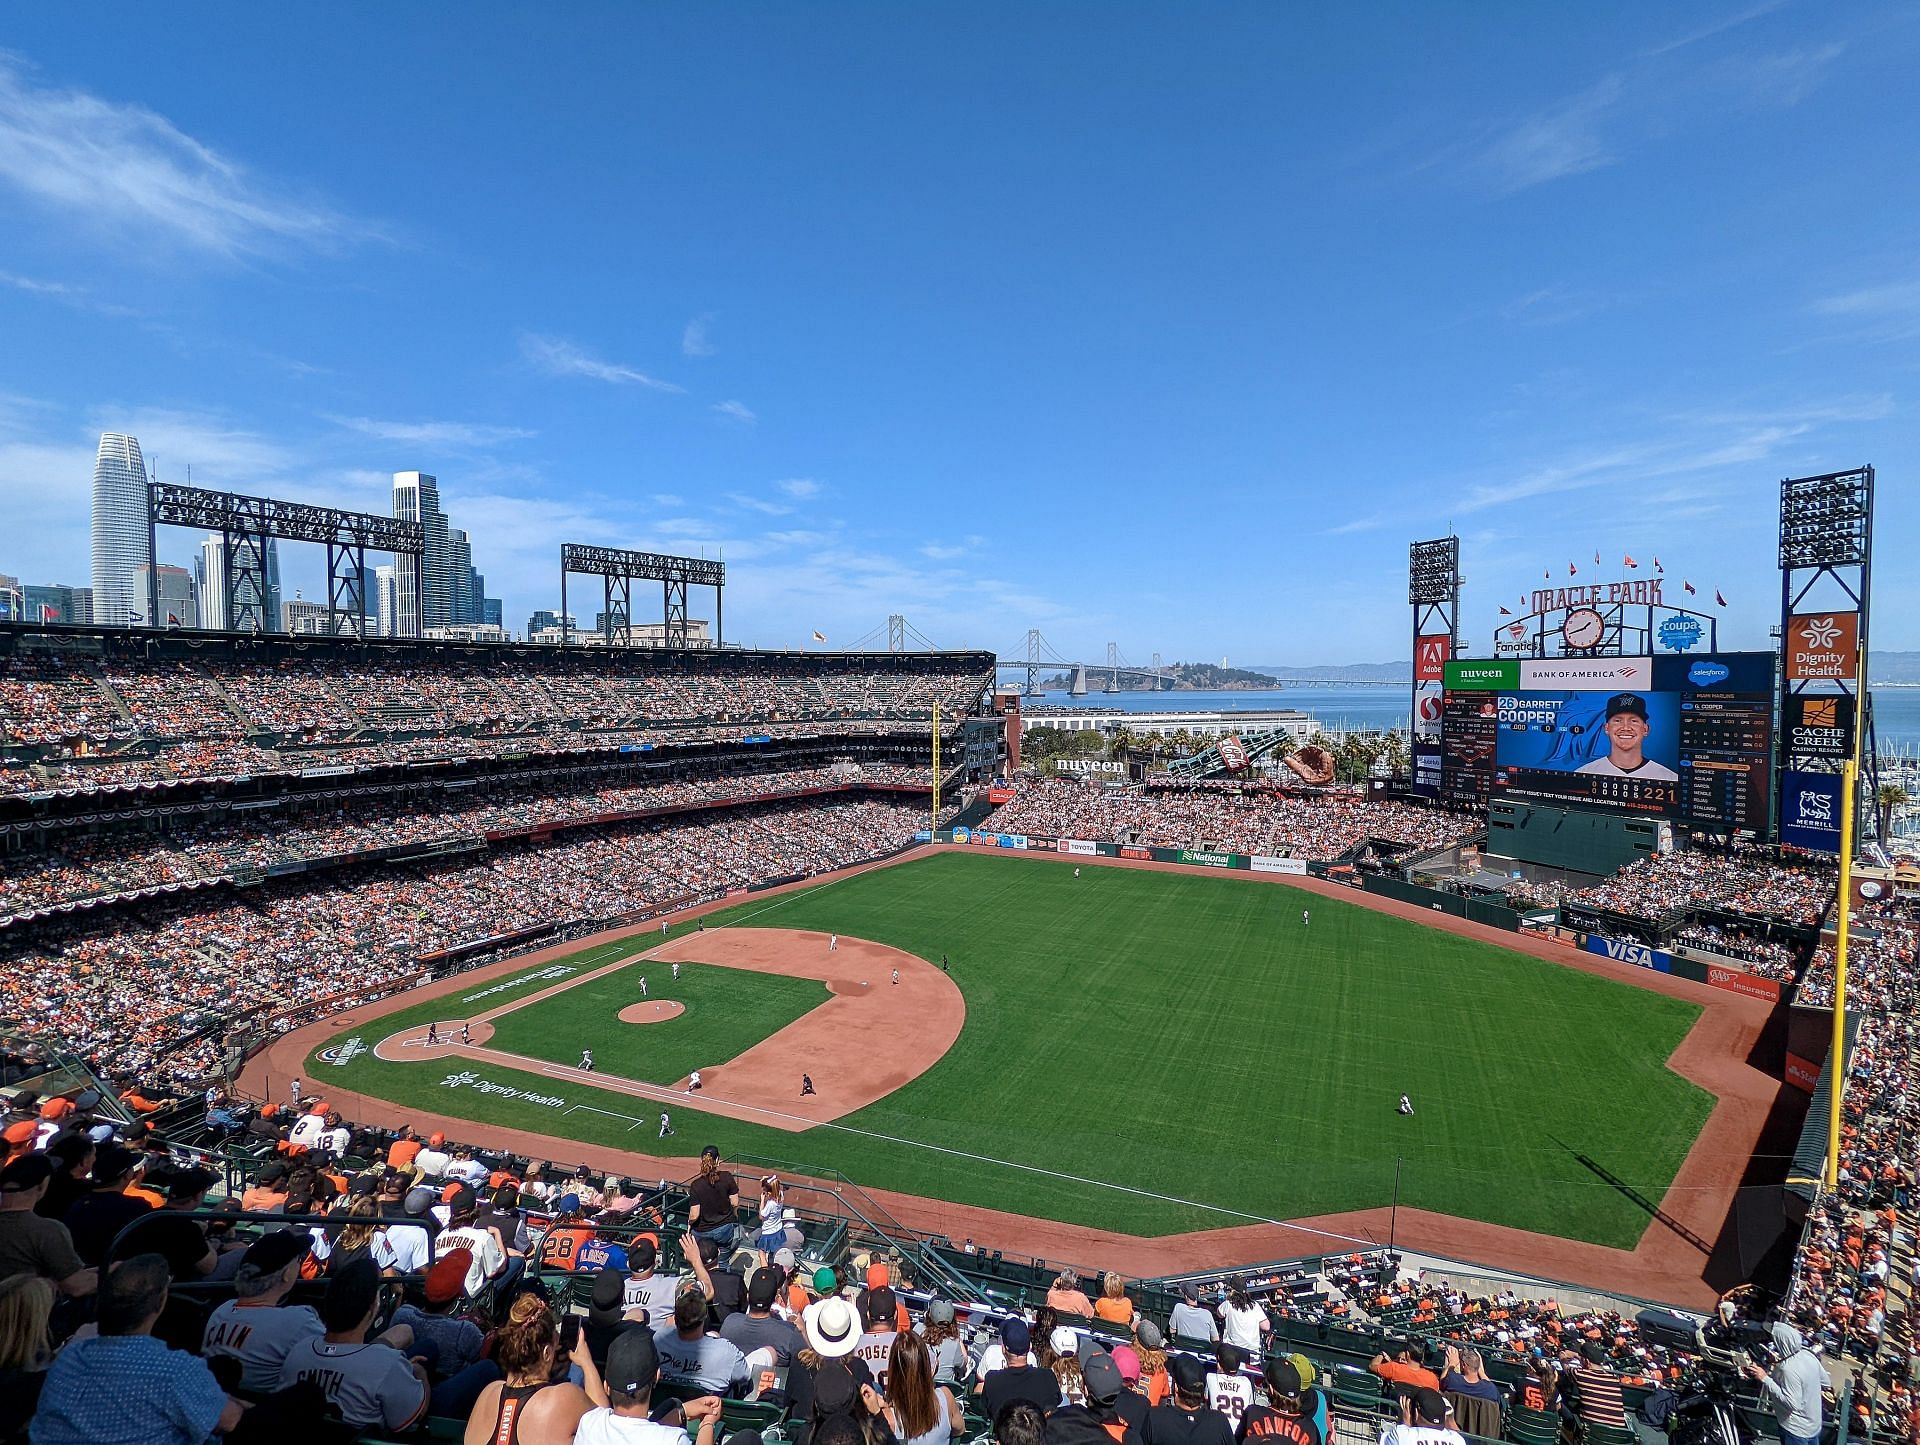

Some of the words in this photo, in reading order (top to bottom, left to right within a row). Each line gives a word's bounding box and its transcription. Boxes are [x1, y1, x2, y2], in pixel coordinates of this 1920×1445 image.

[1532, 585, 1601, 614] ORACLE
[1608, 579, 1664, 606] PARK
[1664, 622, 1697, 632] coupa
[1496, 642, 1537, 651] Fanatics
[1796, 653, 1844, 665] Dignity
[1423, 665, 1442, 673] Adobe
[1460, 669, 1502, 678] nuveen
[1572, 670, 1615, 678] AMERICA
[1798, 665, 1842, 676] Health
[1500, 699, 1514, 708] 26
[1519, 701, 1563, 709] GARRETT
[1499, 711, 1555, 723] COOPER
[1792, 727, 1844, 737] CACHE
[1793, 736, 1842, 746] CREEK
[1057, 759, 1124, 772] nuveen
[1644, 788, 1652, 799] 2
[1655, 789, 1664, 800] 2
[1668, 790, 1674, 801] 1
[680, 802, 711, 810] ORACLE
[1594, 798, 1617, 806] LOCATION
[564, 817, 599, 827] ORACLE
[1796, 819, 1833, 828] MERRILL
[500, 826, 538, 838] ORACLE
[1120, 850, 1139, 859] GAME
[1193, 852, 1229, 863] National
[1679, 938, 1716, 952] WELCOME
[1602, 939, 1653, 967] VISA
[1712, 971, 1728, 980] AAA
[1734, 982, 1776, 998] Insurance
[1800, 1070, 1816, 1085] Stat
[472, 1080, 522, 1098] Dignity
[519, 1091, 564, 1107] Health
[295, 1122, 308, 1135] 8
[318, 1135, 334, 1149] 18
[448, 1167, 467, 1176] WILLIAMS
[436, 1236, 475, 1249] RAWFORD
[544, 1237, 574, 1258] 28
[207, 1323, 252, 1349] CAIN
[858, 1345, 888, 1360] POSE
[1219, 1381, 1240, 1393] POSEY
[1216, 1395, 1244, 1419] 28
[500, 1405, 512, 1441] GIANTS
